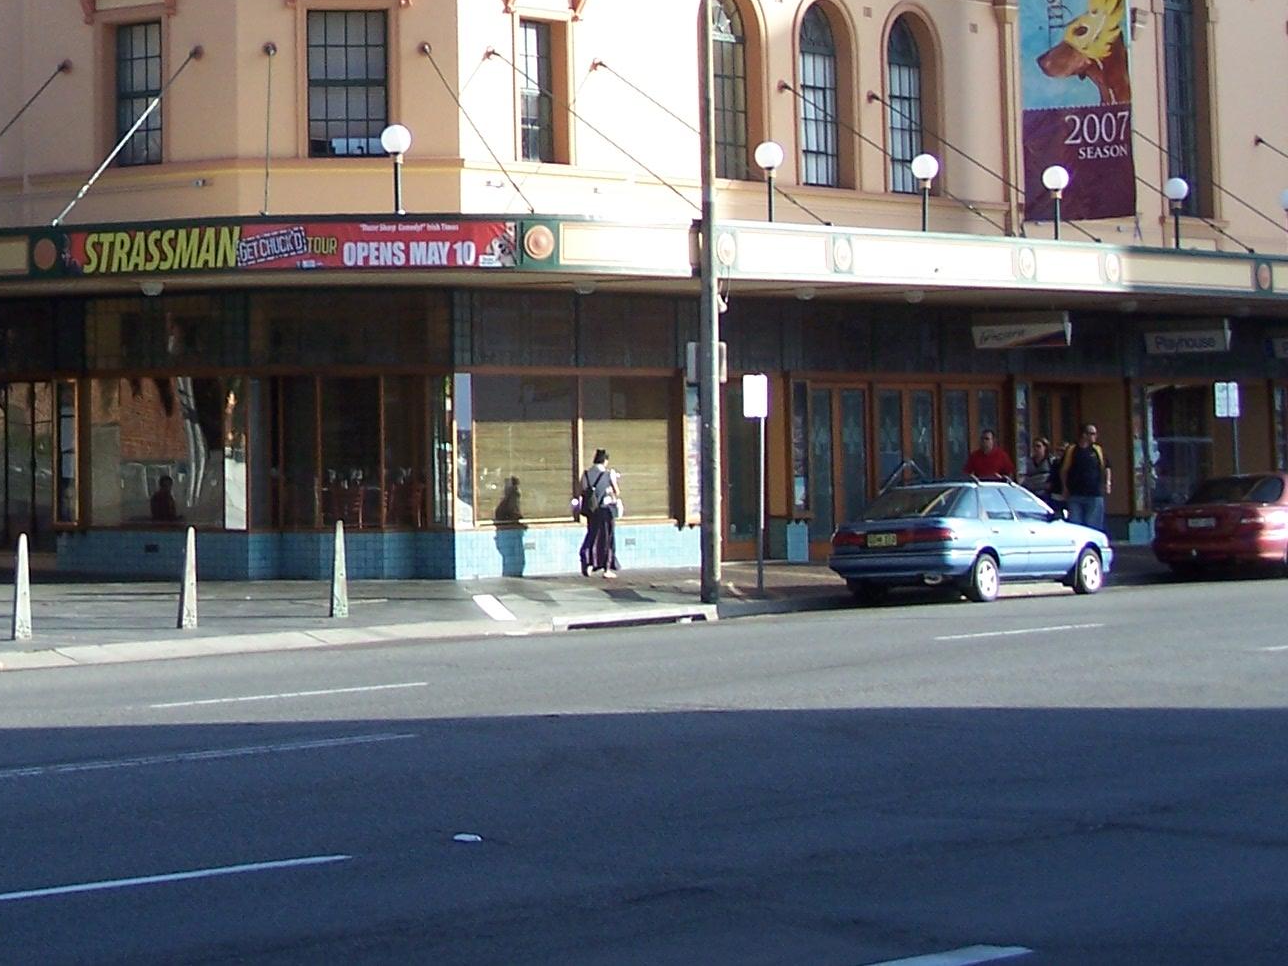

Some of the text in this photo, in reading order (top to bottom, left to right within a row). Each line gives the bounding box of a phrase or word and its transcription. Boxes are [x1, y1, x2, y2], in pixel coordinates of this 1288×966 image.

[1065, 111, 1129, 145] 2007
[1078, 145, 1128, 159] SEASON
[83, 226, 241, 274] STRASSMAN
[239, 241, 260, 262] GET
[307, 236, 338, 255] TOUR
[343, 241, 406, 266] OPENS
[410, 241, 450, 265] MAY
[453, 241, 476, 265] 10
